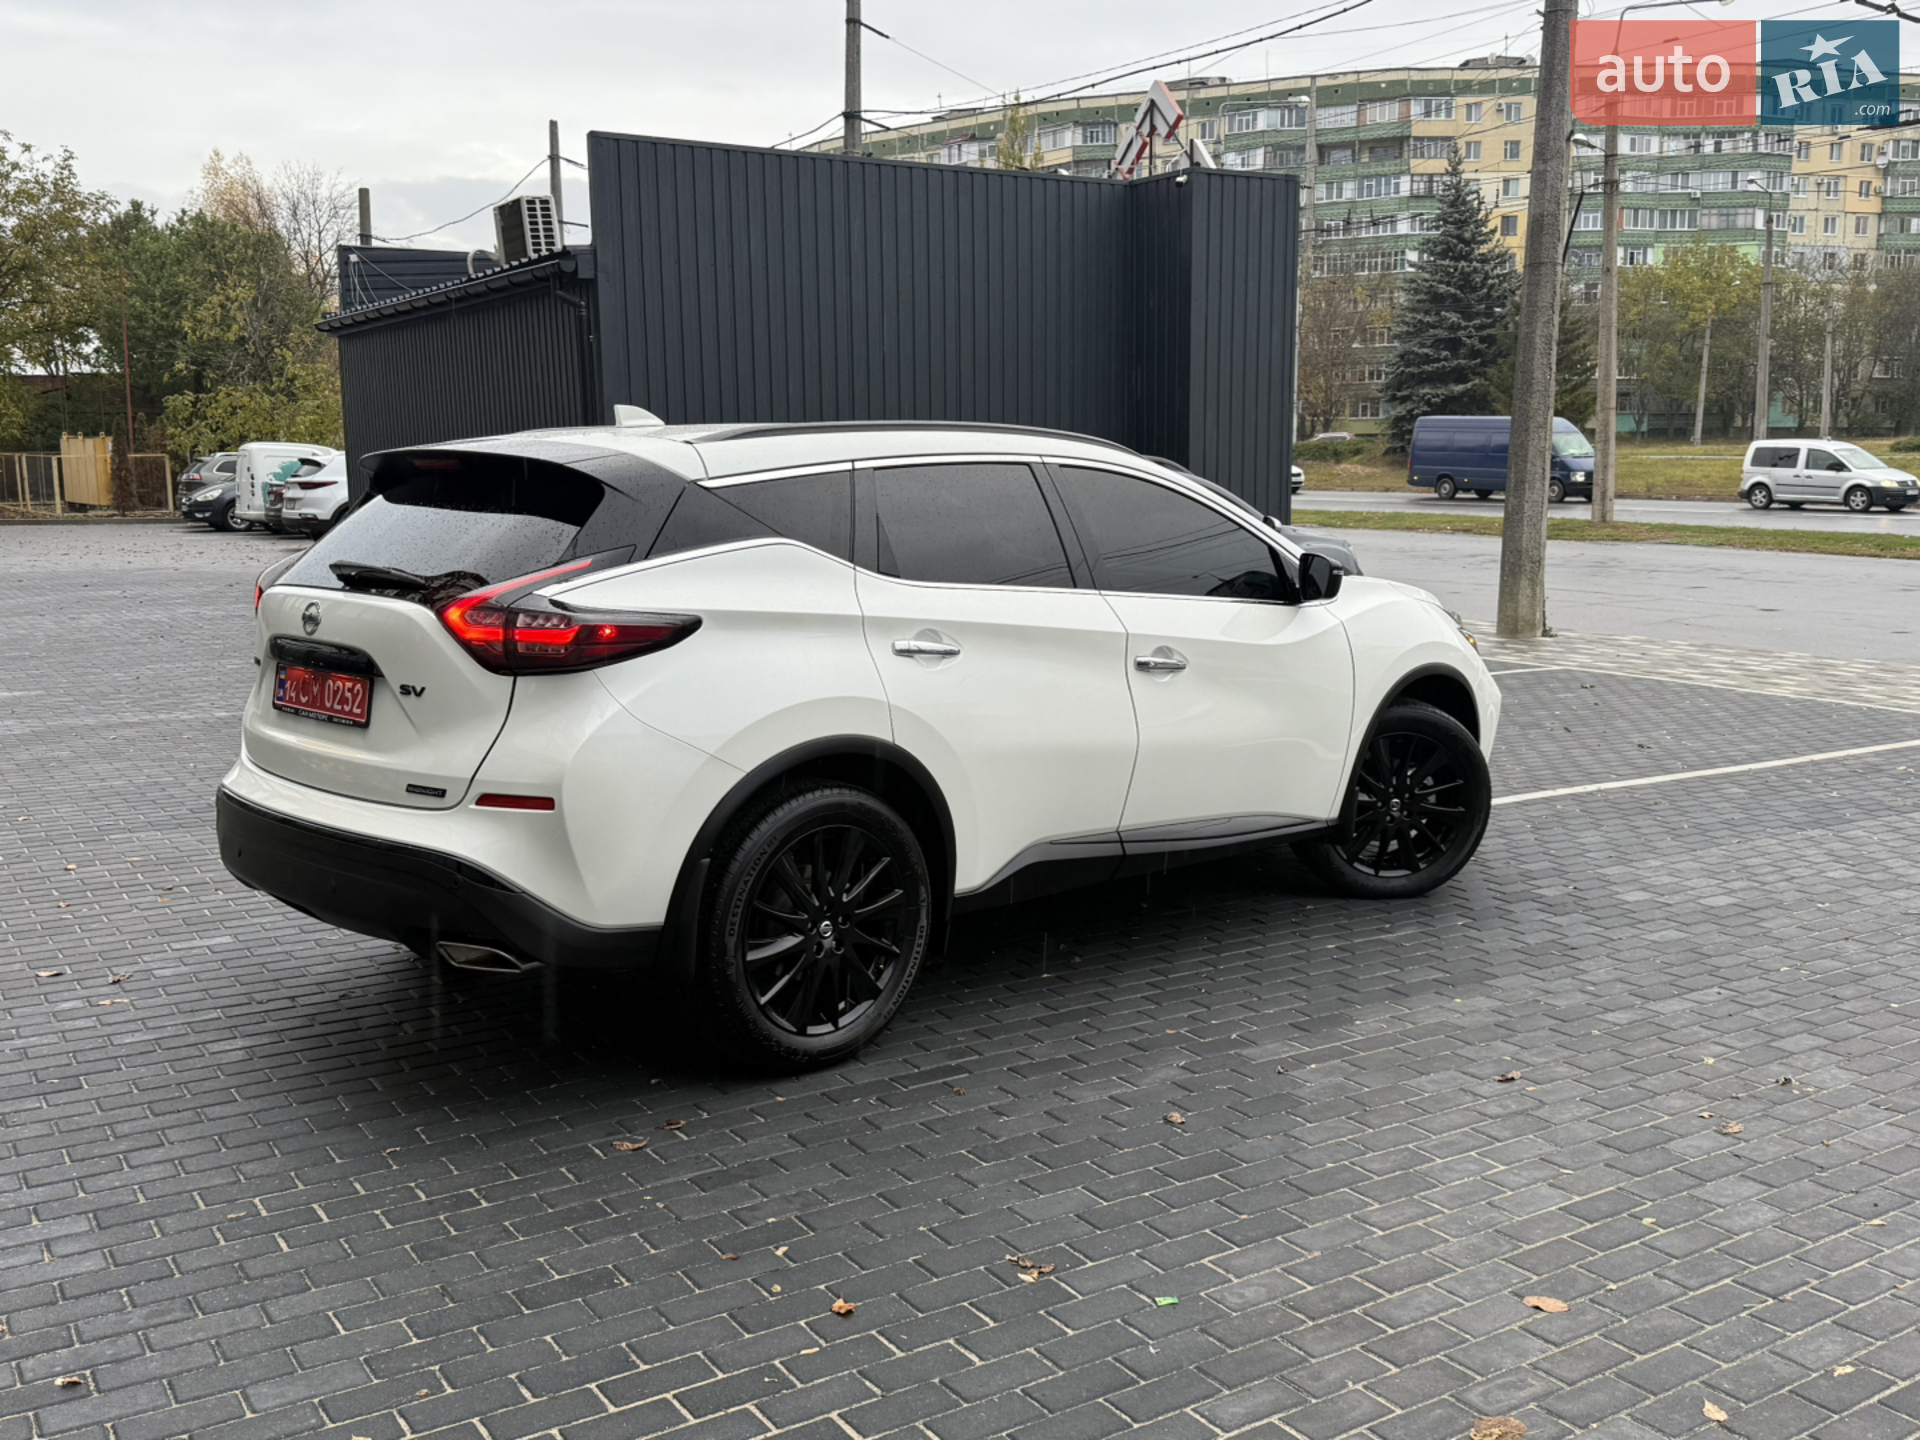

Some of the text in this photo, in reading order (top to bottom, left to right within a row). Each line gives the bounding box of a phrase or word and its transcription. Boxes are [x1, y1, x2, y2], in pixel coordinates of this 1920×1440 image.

[285, 680, 297, 702] 14
[324, 679, 363, 714] 0252
[399, 684, 426, 697] SV
[728, 848, 768, 936] DESTINATION
[893, 924, 926, 1008] DESTINATION
